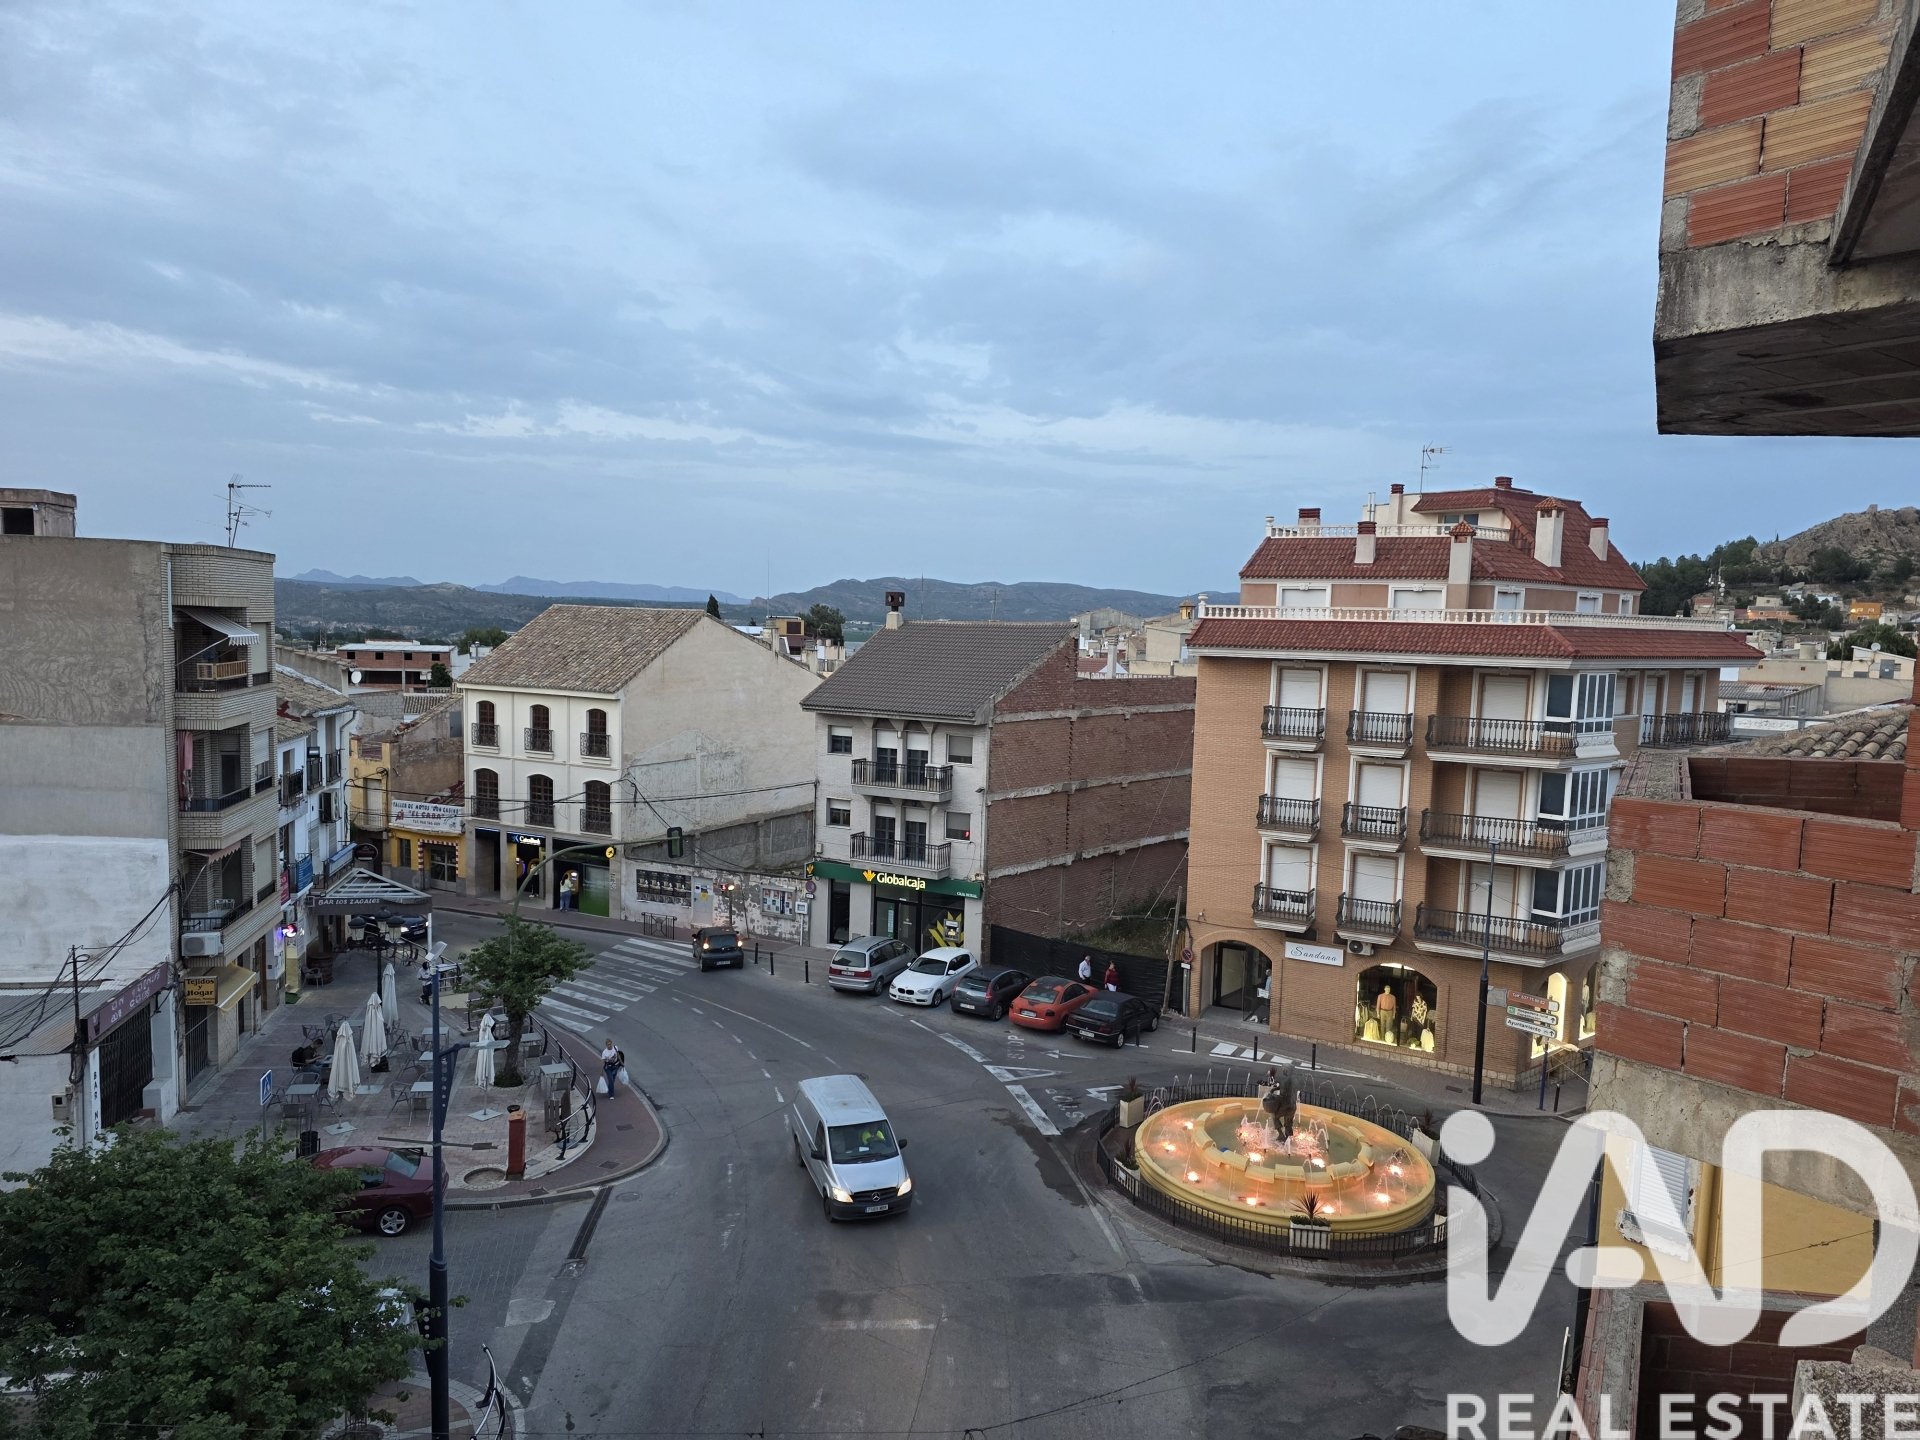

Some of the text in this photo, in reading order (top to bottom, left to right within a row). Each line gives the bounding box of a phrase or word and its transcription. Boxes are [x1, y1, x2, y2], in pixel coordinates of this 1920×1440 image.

[876, 872, 926, 890] Globalcaja
[1291, 946, 1337, 962] Sandana
[1507, 1019, 1542, 1033] Ayuntamiento
[1007, 1035, 1025, 1060] STOP
